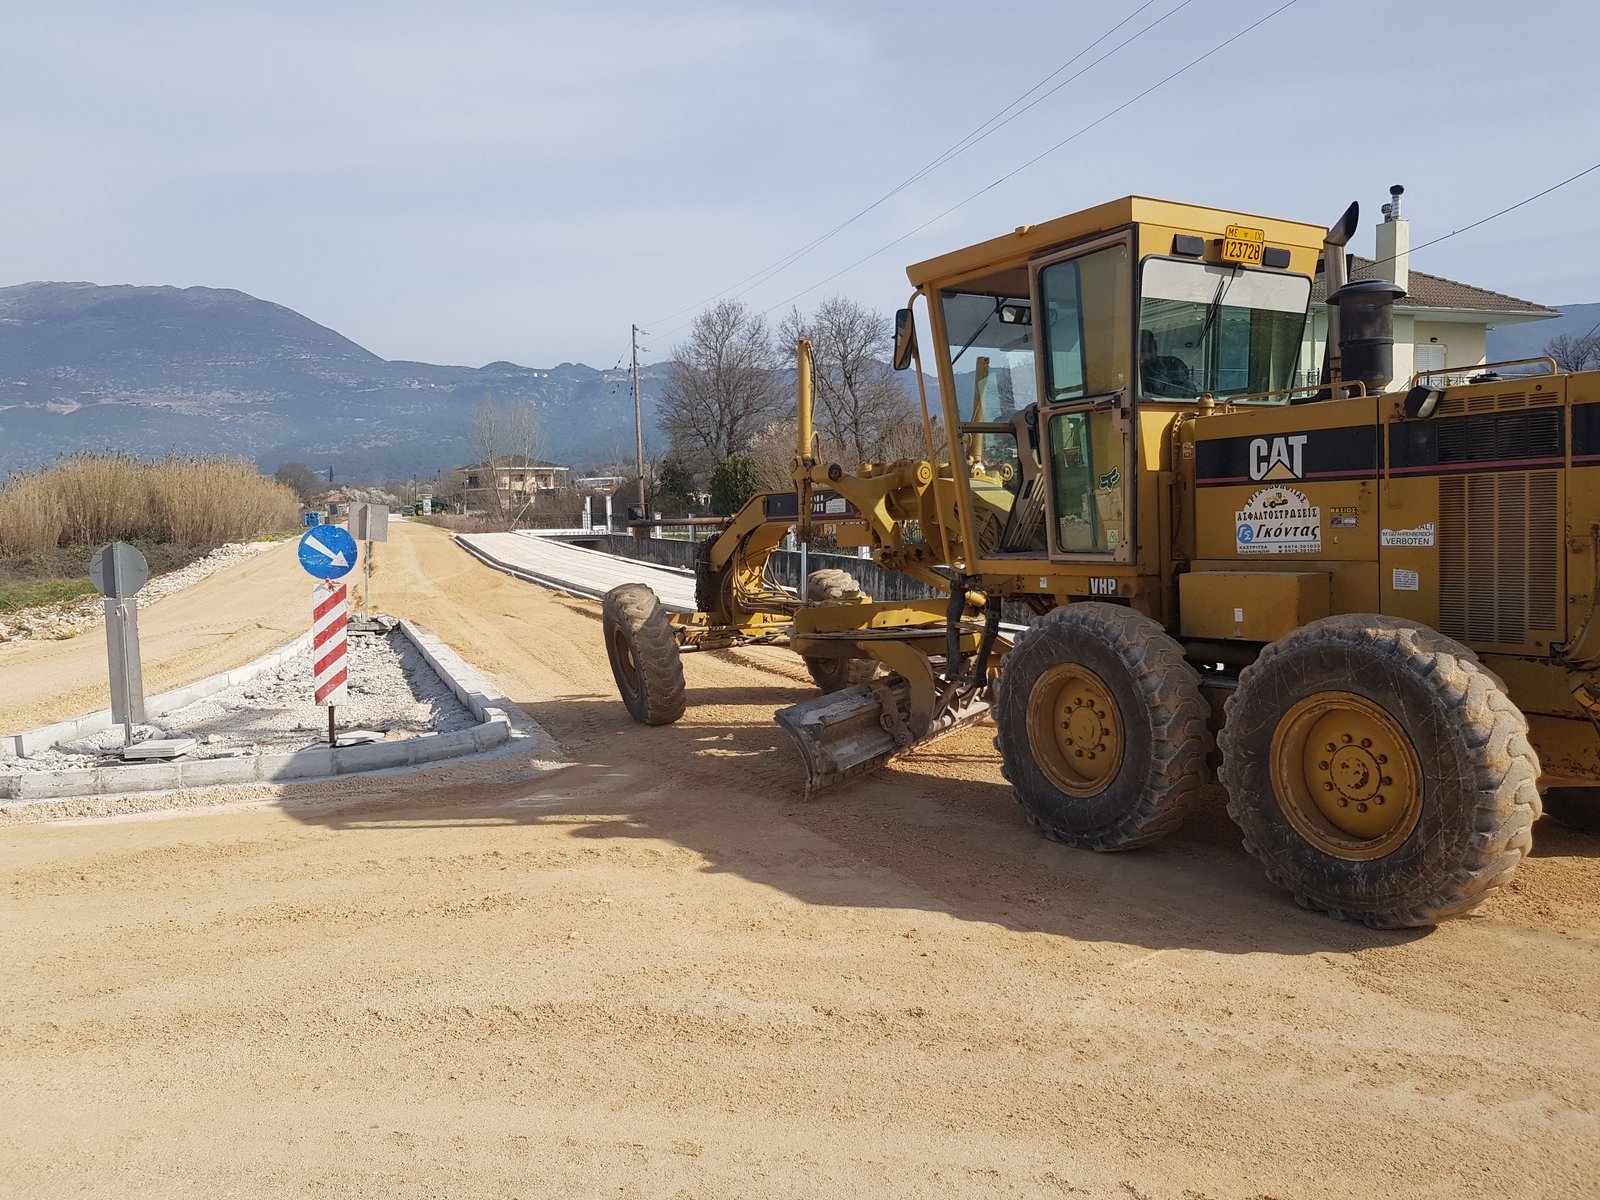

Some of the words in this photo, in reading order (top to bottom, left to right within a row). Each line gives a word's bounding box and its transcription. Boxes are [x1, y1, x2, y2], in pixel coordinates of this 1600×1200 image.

[1225, 241, 1260, 260] 123728
[1250, 435, 1307, 480] CAT
[1256, 523, 1319, 540] Γκόντας
[1385, 537, 1430, 545] VERBOTEN
[1090, 578, 1116, 594] VHP
